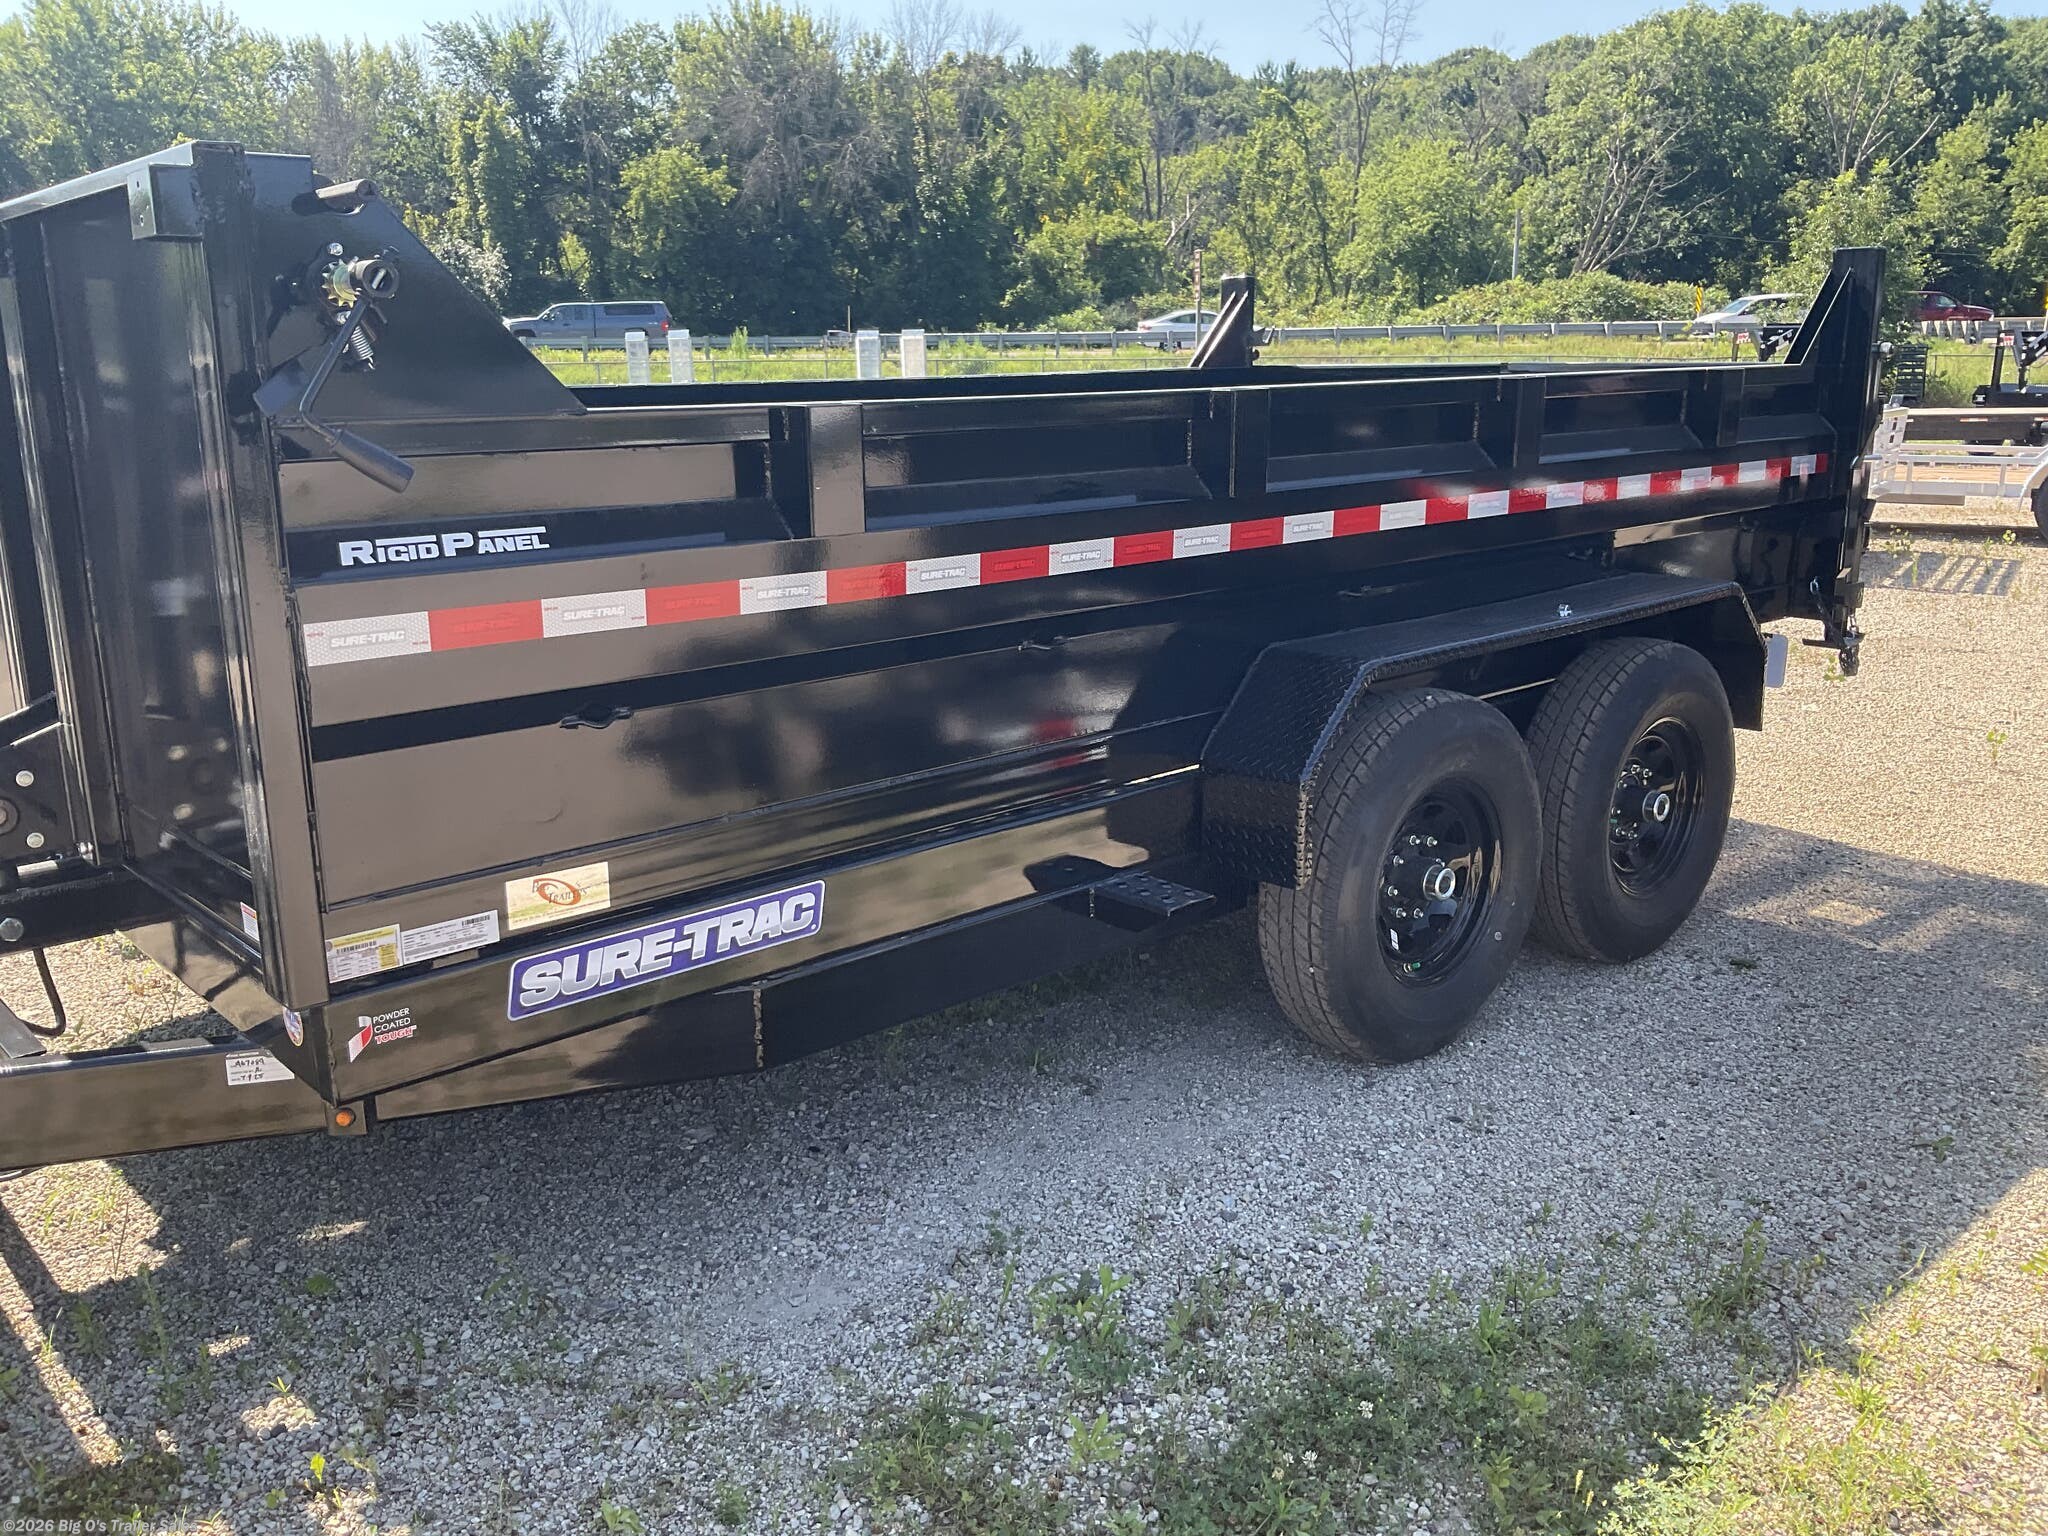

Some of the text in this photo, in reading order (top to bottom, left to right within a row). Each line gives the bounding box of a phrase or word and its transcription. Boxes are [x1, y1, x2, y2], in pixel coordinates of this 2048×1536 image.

[338, 526, 550, 566] RIGID PANEL
[1061, 550, 1101, 562] SURE-TRAC
[920, 567, 966, 581] SURE-TRAC
[757, 586, 810, 600] SURE-TRAC
[563, 606, 626, 621] SURE-TRAC
[331, 630, 406, 648] SURE-TRAC
[519, 892, 817, 1007] SURE-TRAC
[372, 1007, 411, 1025] POWDER
[374, 1017, 412, 1034] COATED
[374, 1026, 416, 1045] TOUGH
